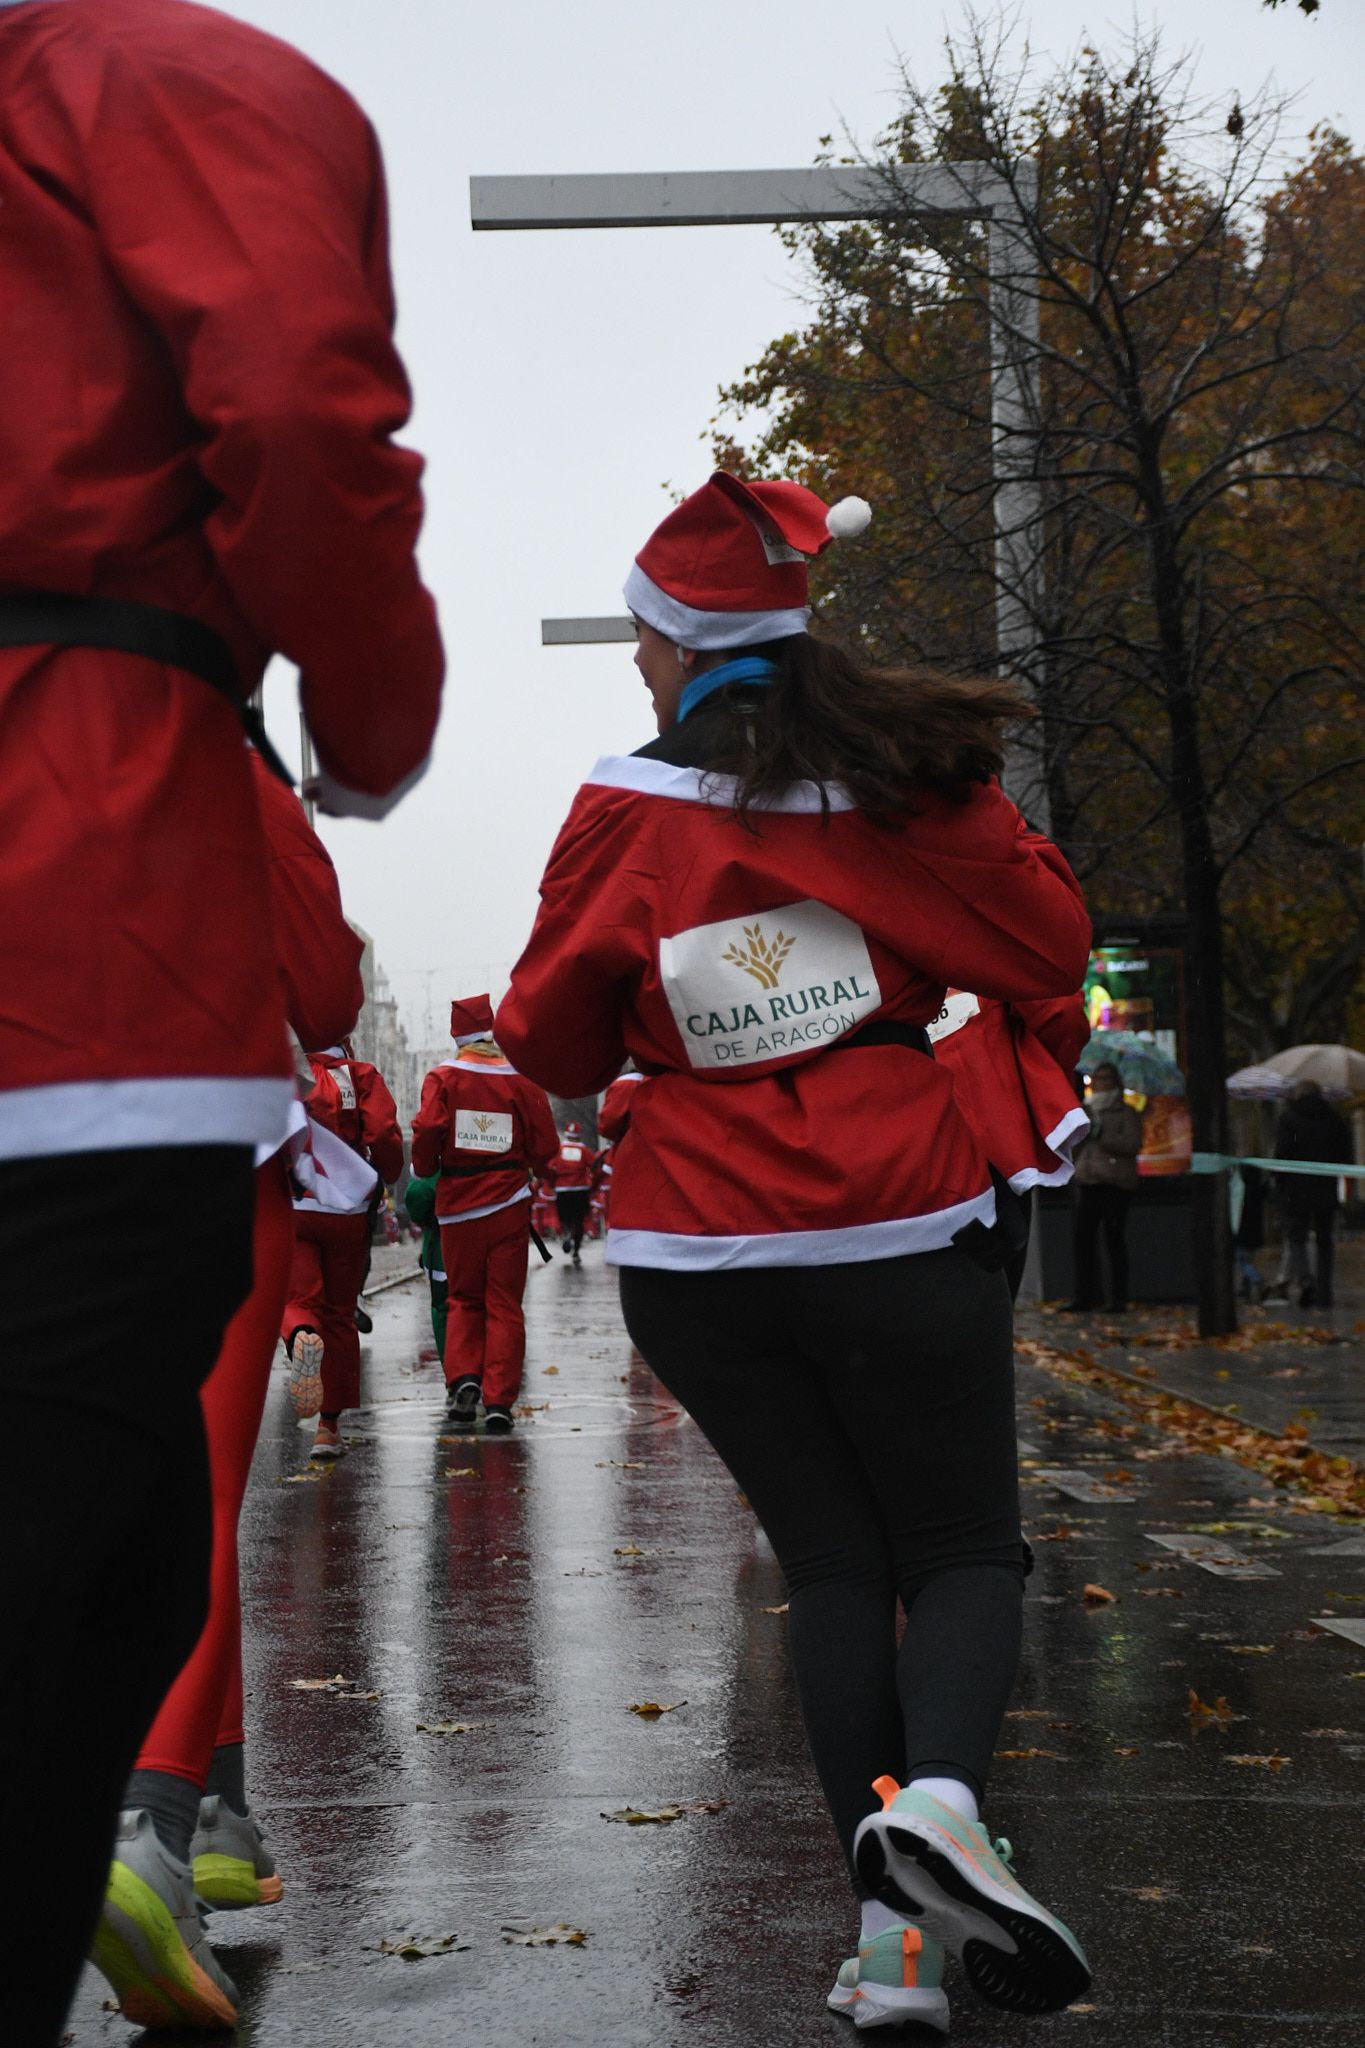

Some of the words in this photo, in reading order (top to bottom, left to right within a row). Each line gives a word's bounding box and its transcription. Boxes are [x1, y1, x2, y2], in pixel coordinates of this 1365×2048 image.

[686, 1003, 764, 1037] CAJA
[768, 976, 870, 1022] RURAL
[714, 1040, 747, 1061] DE
[755, 1012, 856, 1055] ARAGÓN
[457, 1131, 479, 1141] CAJA
[481, 1134, 508, 1144] RURAL
